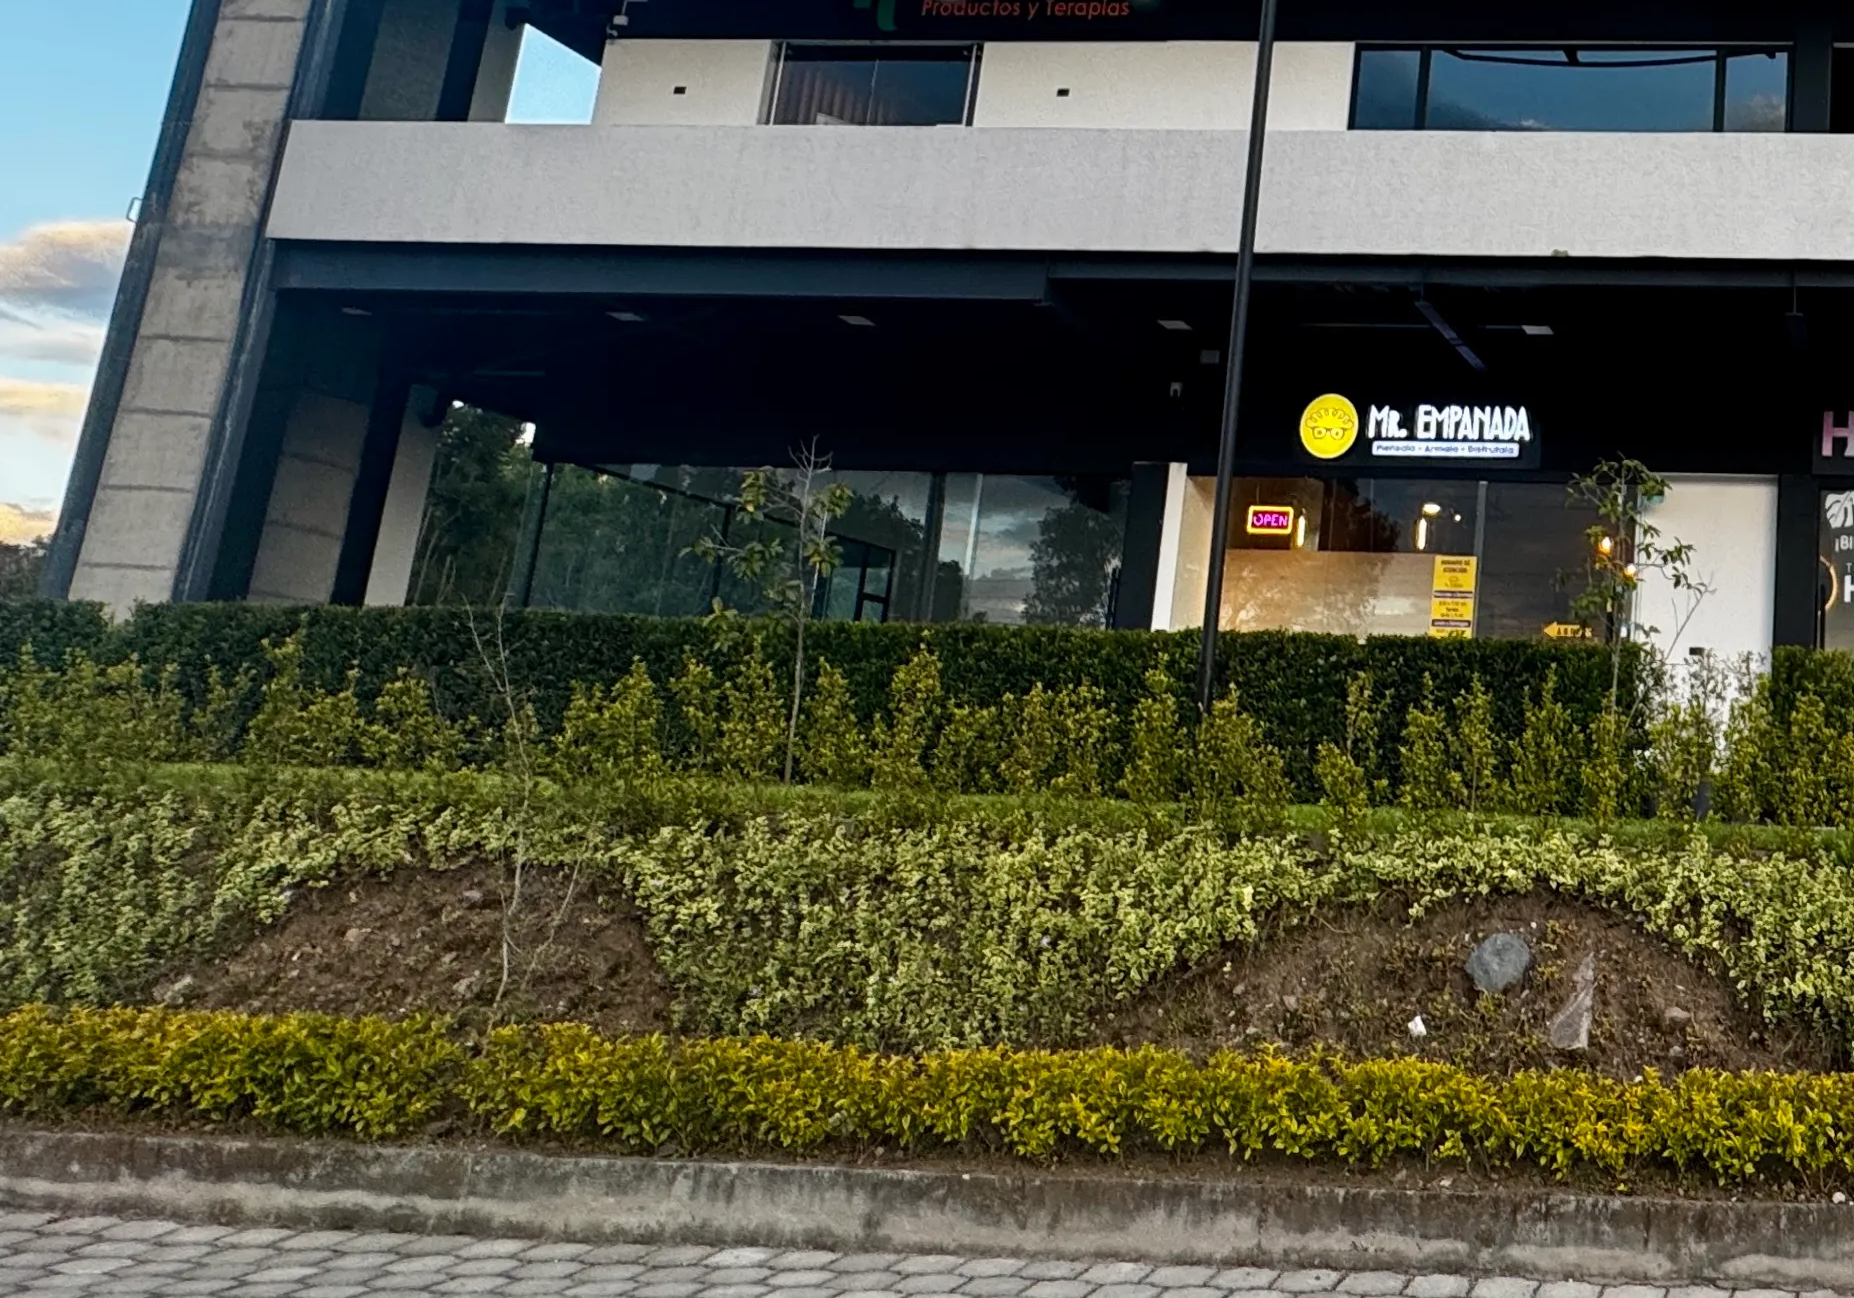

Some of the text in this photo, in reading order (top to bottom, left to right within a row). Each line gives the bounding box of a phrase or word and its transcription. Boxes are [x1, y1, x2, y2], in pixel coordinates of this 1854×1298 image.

[1028, 2, 1040, 20] y
[1416, 404, 1531, 441] EMPANADA
[1253, 513, 1288, 527] OPEN
